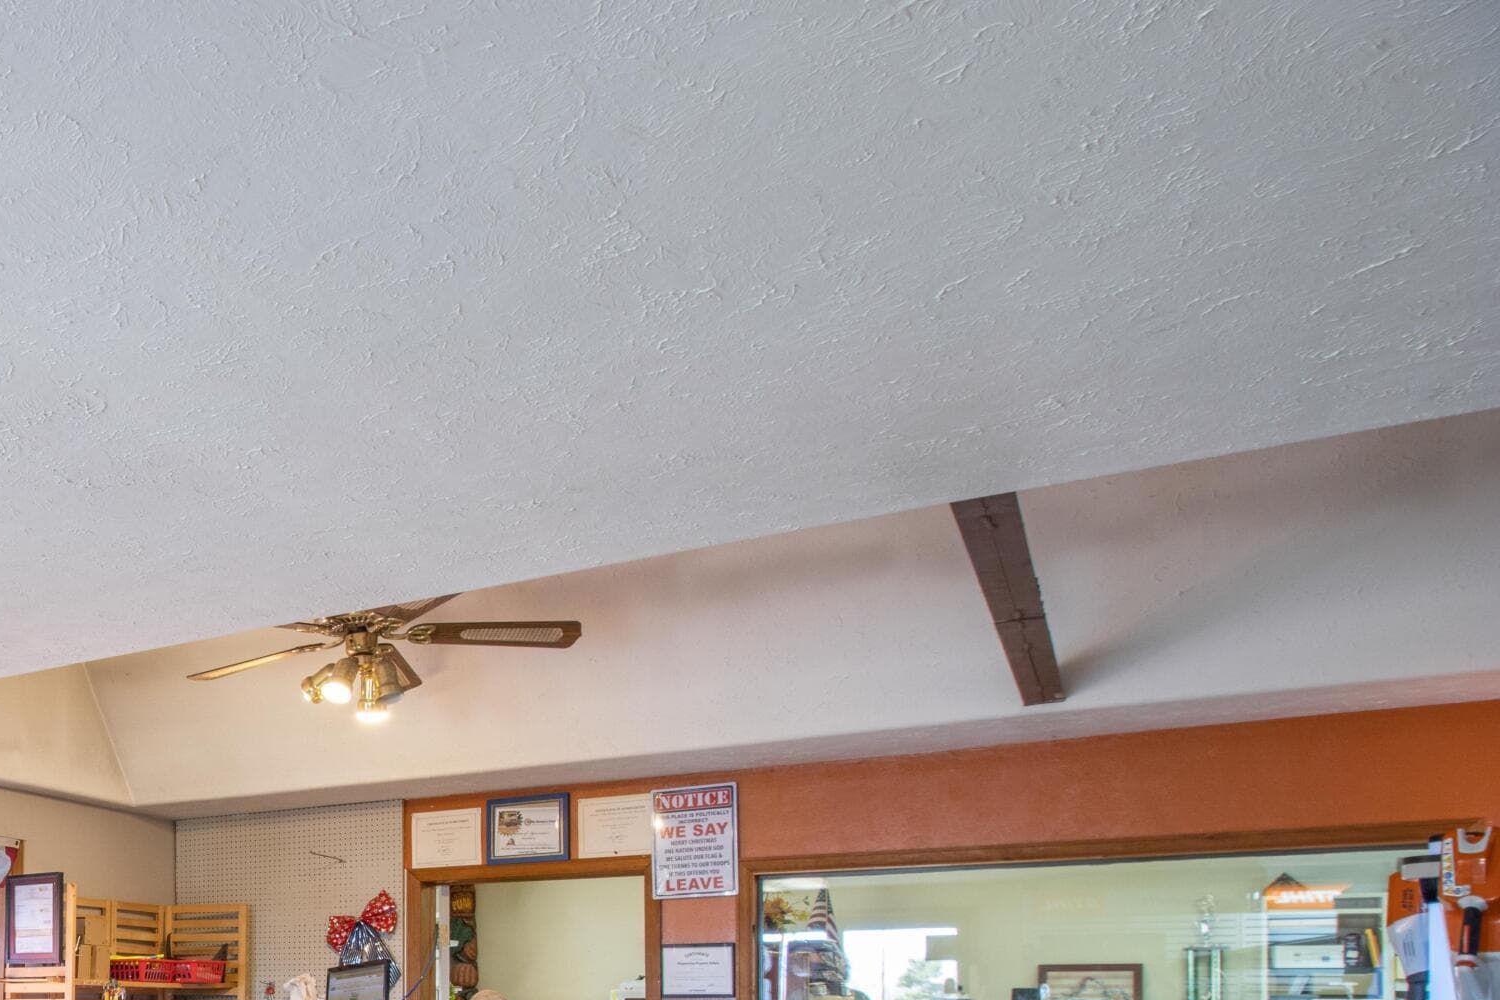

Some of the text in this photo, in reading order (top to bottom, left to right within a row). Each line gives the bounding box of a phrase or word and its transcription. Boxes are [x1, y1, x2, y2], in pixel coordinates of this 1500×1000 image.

[660, 790, 729, 809] NOTICE
[695, 810, 729, 818] POLITICALLY
[660, 822, 729, 839] WE SAY
[665, 876, 724, 892] LEAVE
